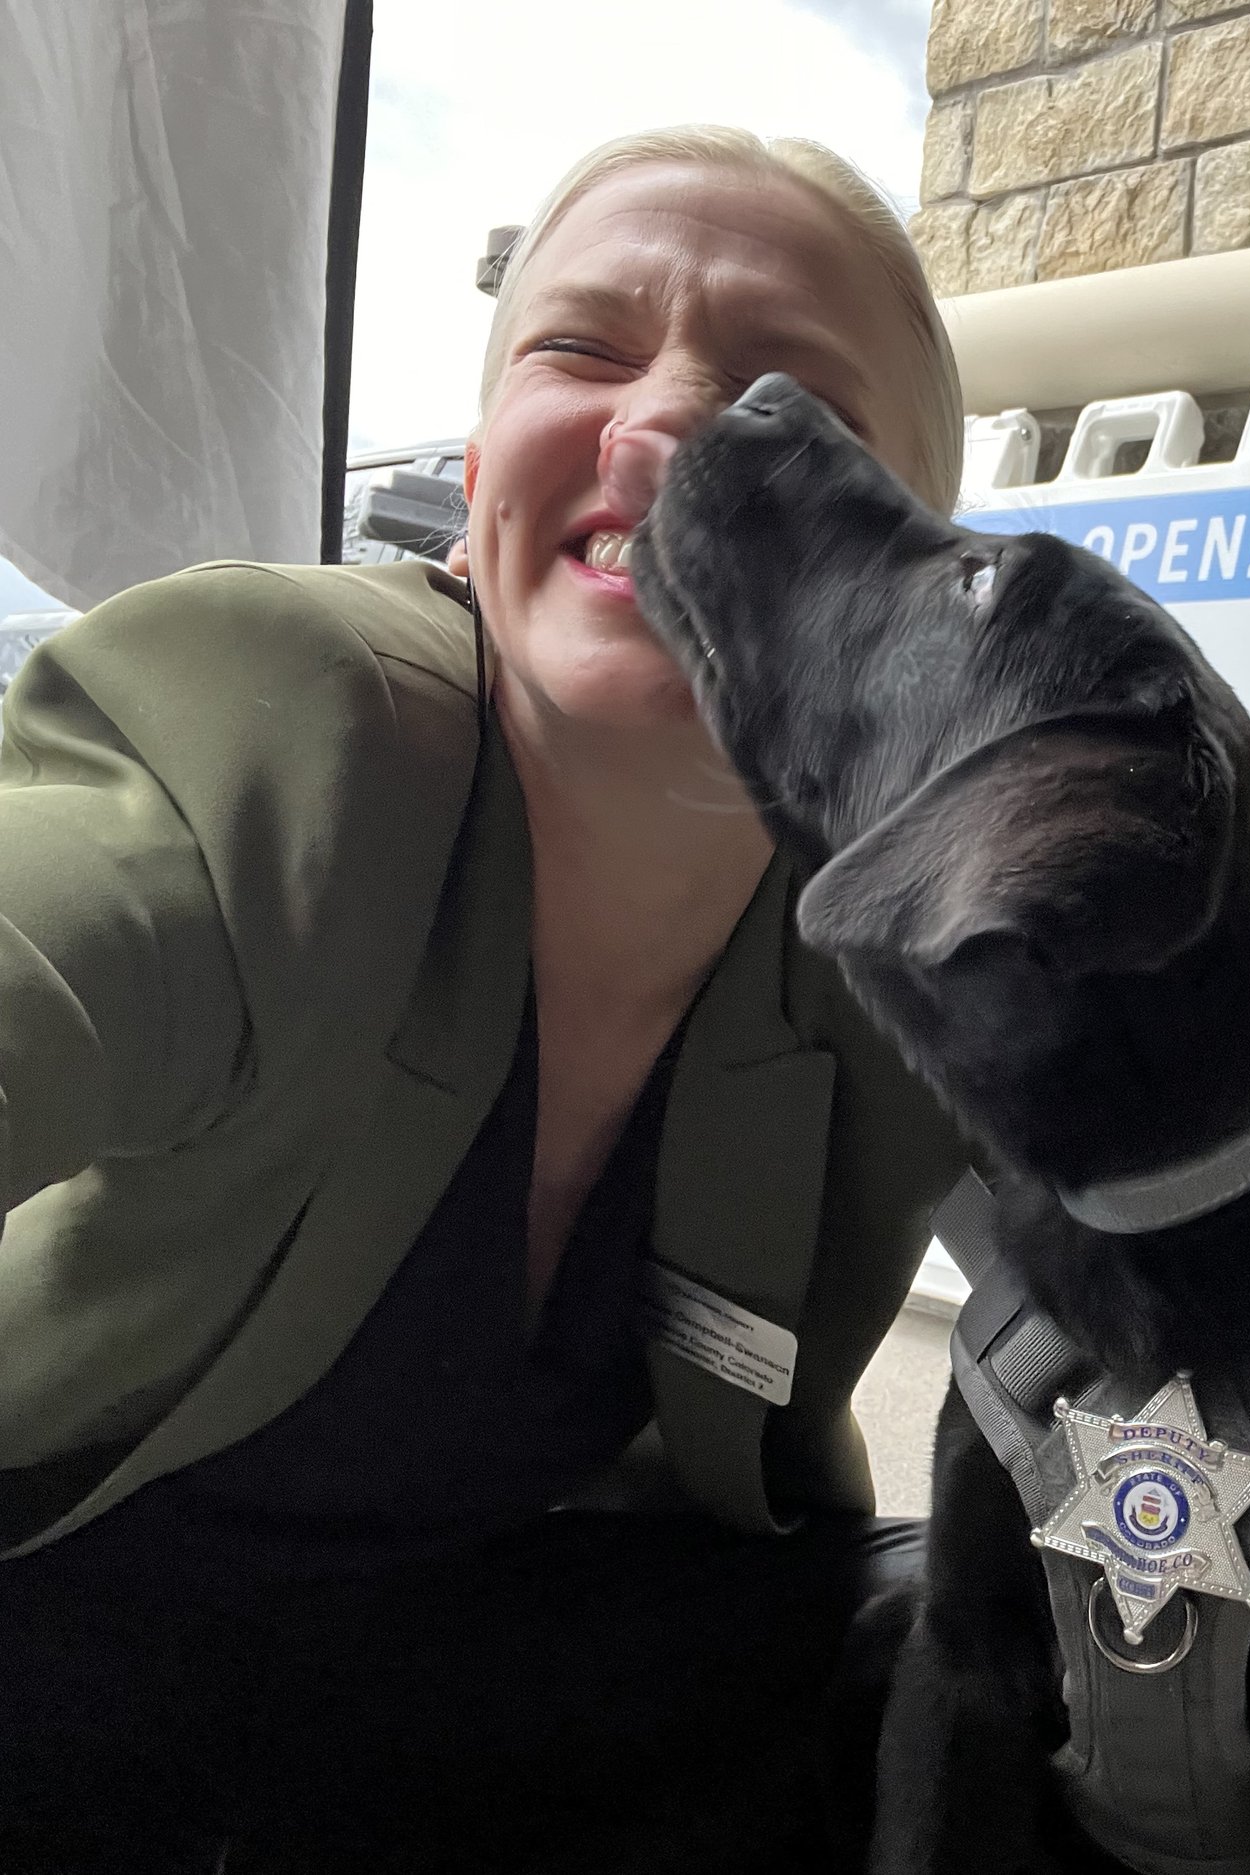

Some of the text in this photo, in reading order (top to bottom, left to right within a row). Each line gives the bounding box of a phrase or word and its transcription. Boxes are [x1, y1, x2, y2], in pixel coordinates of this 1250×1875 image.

[1123, 1426, 1209, 1460] DEPUTY
[1130, 1472, 1163, 1486] STATE
[1119, 1522, 1177, 1550] COLORADO
